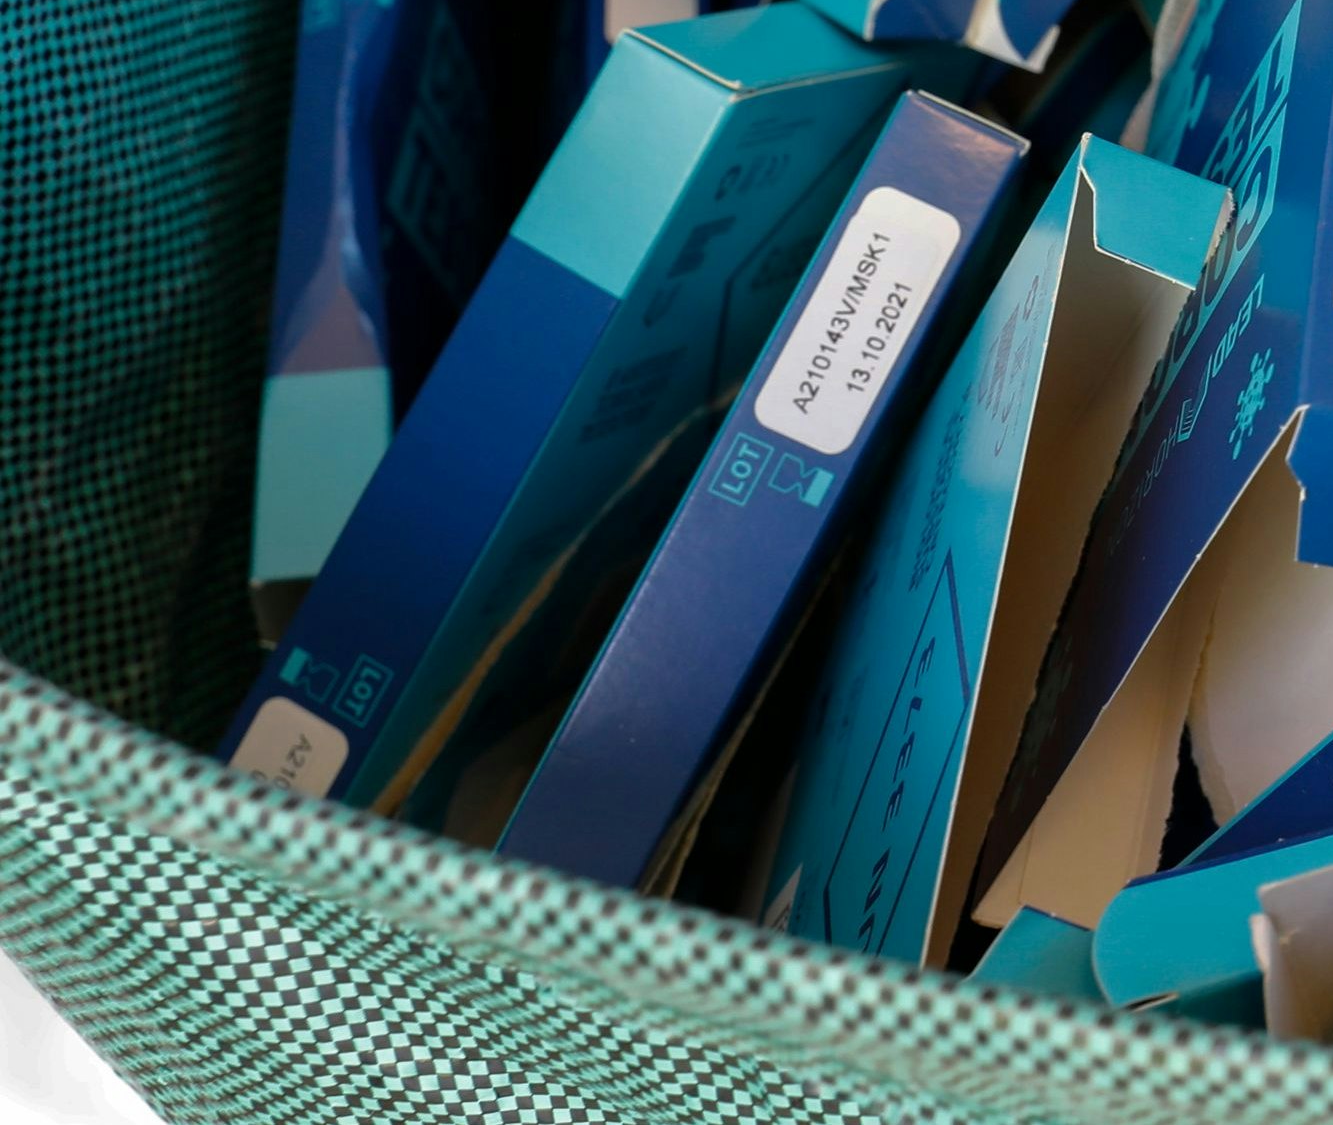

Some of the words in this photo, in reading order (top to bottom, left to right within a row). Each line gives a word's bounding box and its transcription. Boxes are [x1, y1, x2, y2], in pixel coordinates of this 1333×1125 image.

[792, 231, 892, 415] A210143V/MSK1
[846, 282, 913, 393] 13.10.2021
[1212, 273, 1264, 378] LEAD
[721, 442, 760, 495] LOT
[345, 666, 381, 717] LOT
